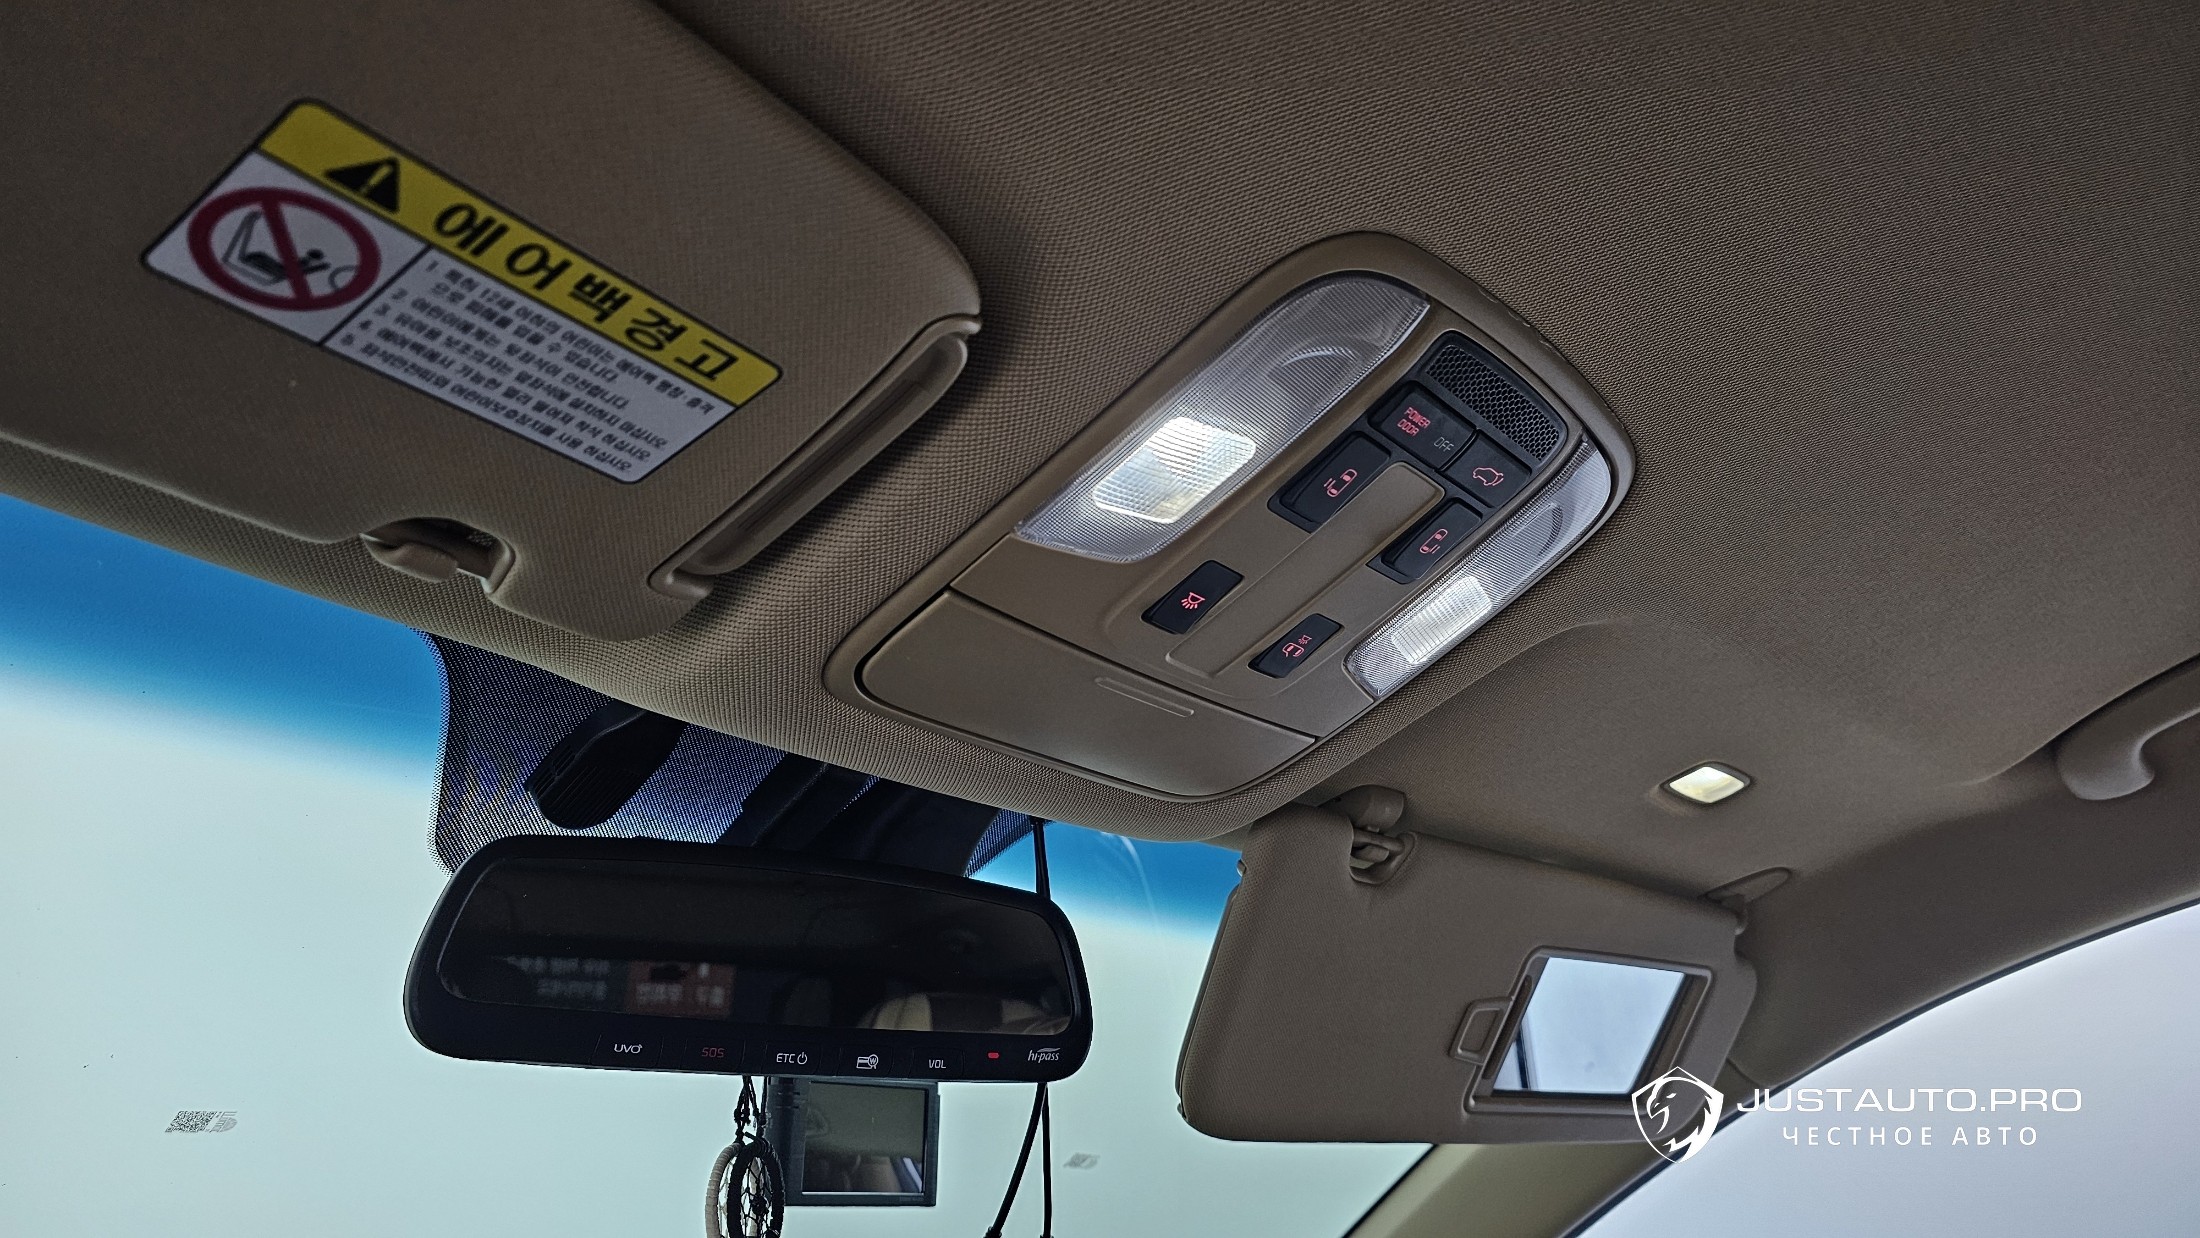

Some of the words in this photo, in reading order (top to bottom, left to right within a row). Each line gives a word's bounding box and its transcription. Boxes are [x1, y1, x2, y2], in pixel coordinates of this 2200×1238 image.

[1403, 406, 1431, 429] POWER
[1397, 418, 1420, 437] DOOR
[1433, 436, 1455, 452] OFF
[701, 1047, 725, 1058] SOS
[776, 1053, 795, 1064] ETC
[928, 1059, 946, 1069] VOL
